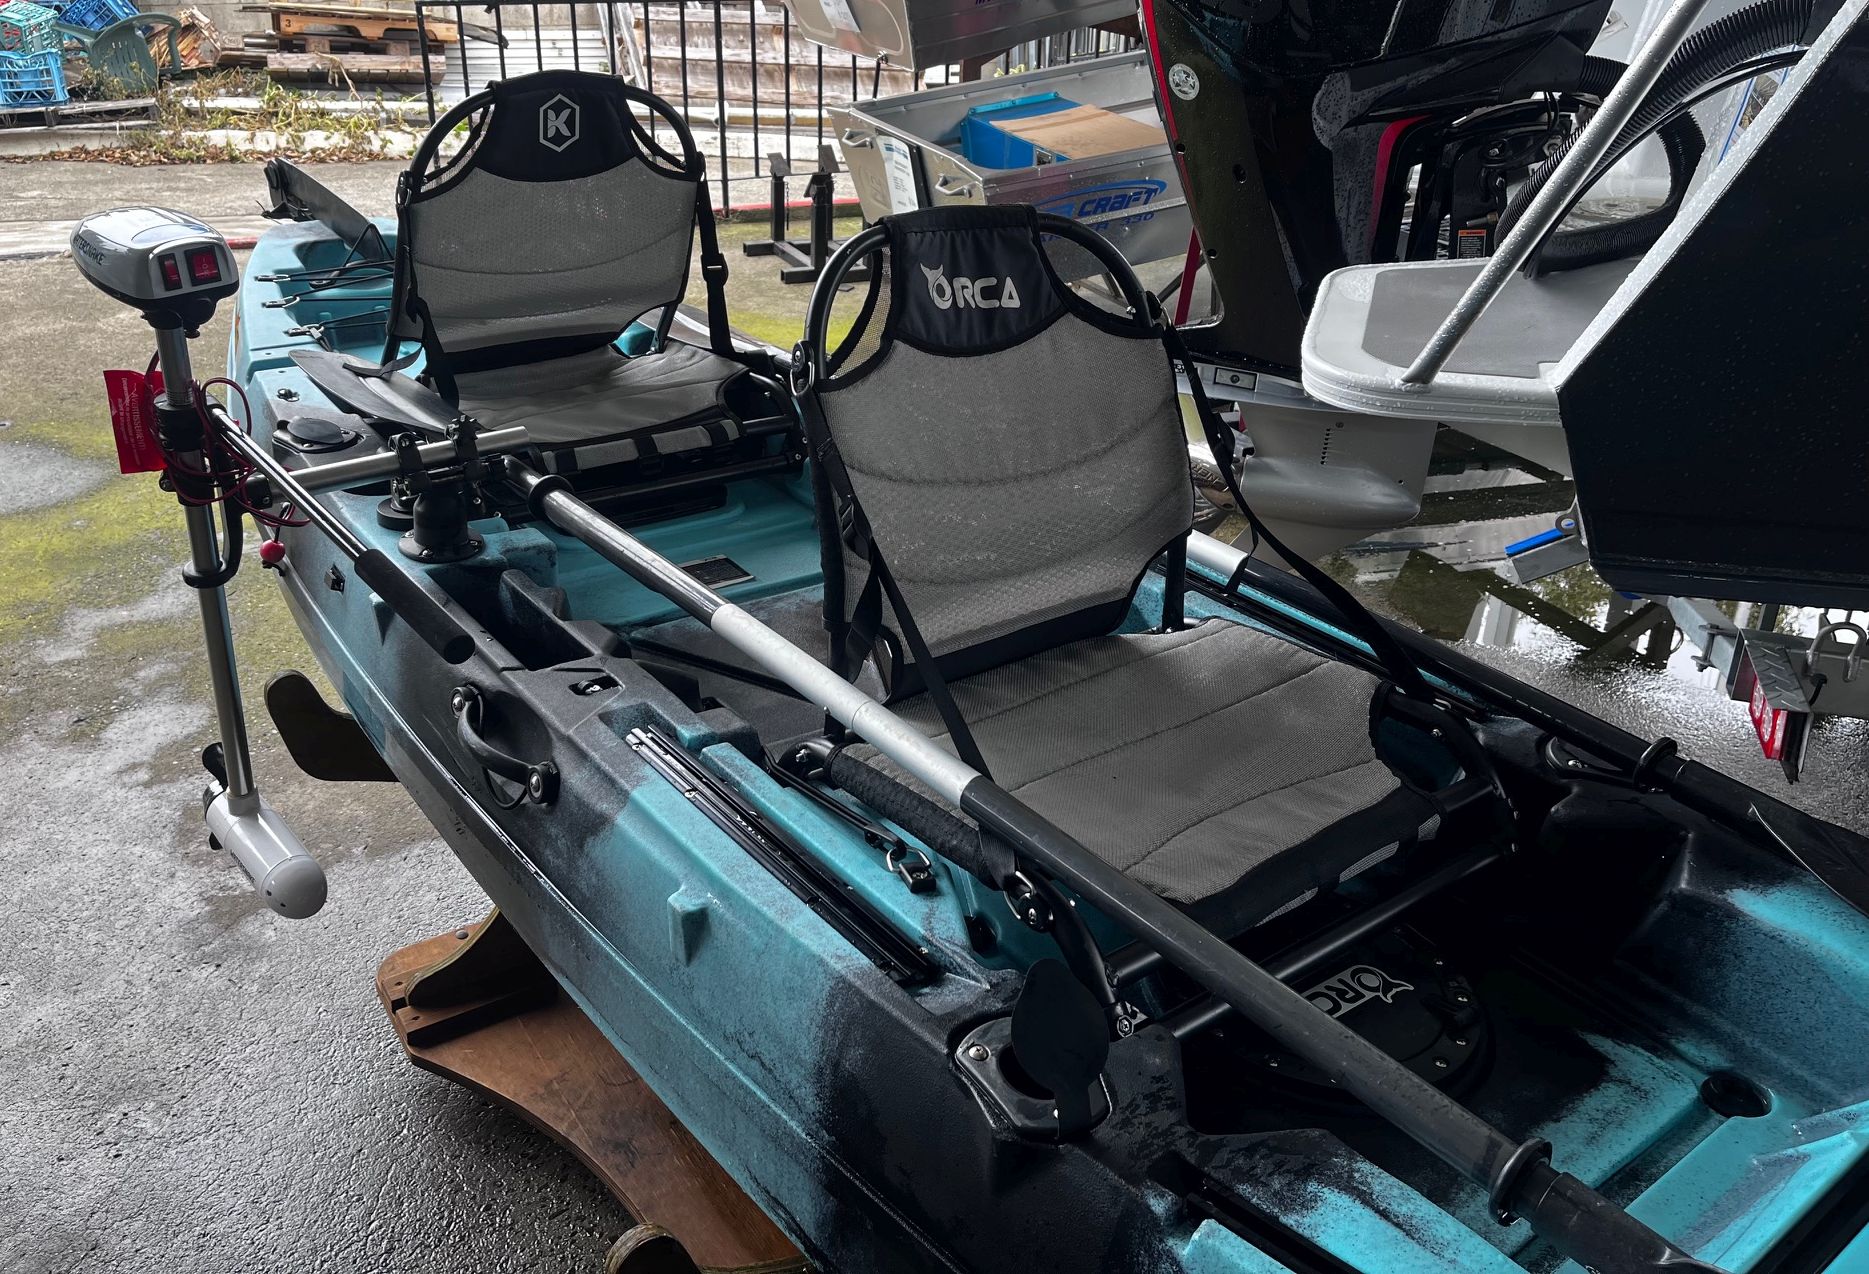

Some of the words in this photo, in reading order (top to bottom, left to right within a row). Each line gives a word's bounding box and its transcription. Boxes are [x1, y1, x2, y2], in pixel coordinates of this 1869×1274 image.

[285, 19, 291, 28] 3
[920, 262, 1021, 310] ORCA
[1301, 965, 1415, 1018] ORC
